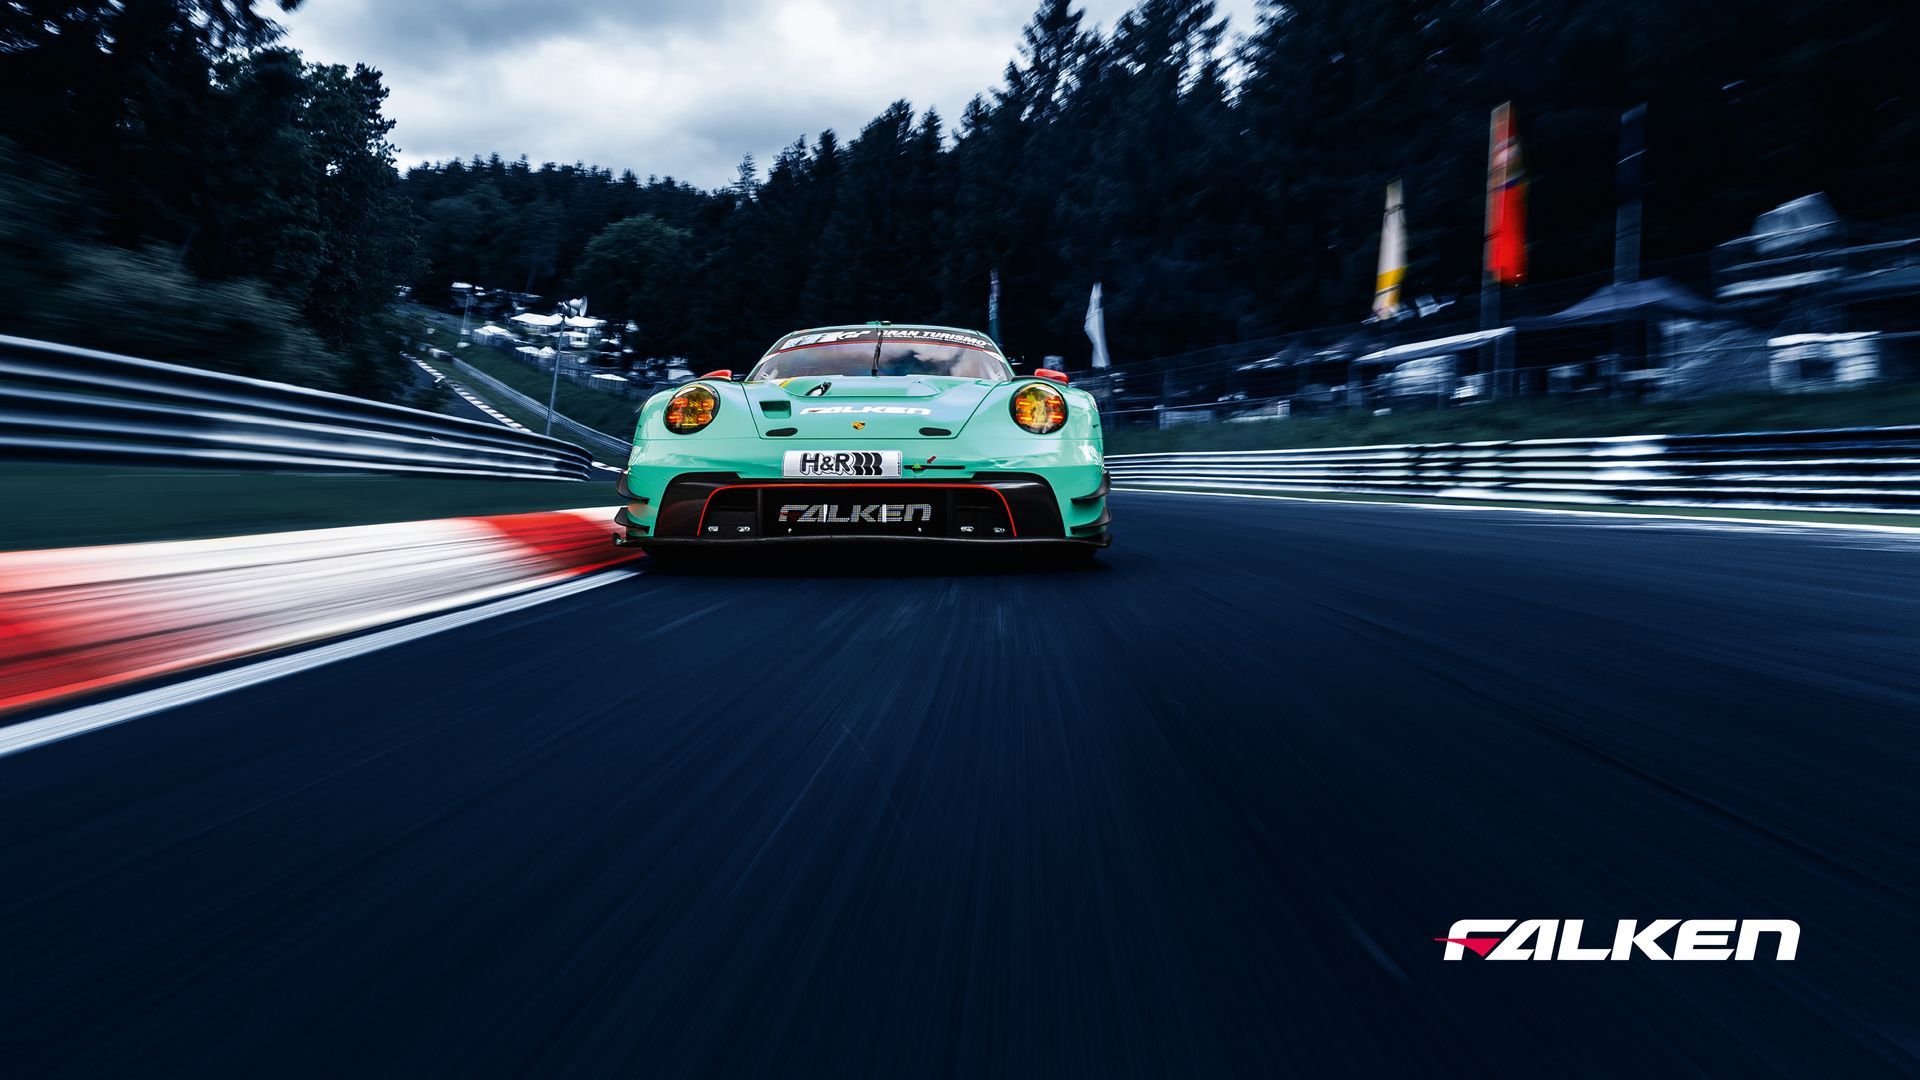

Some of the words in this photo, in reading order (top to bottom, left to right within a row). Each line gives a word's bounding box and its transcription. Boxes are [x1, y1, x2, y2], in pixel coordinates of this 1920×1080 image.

[923, 331, 987, 346] TURISMO
[799, 407, 932, 416] FALKEN
[801, 453, 853, 474] H&R
[779, 504, 932, 523] FALKEN
